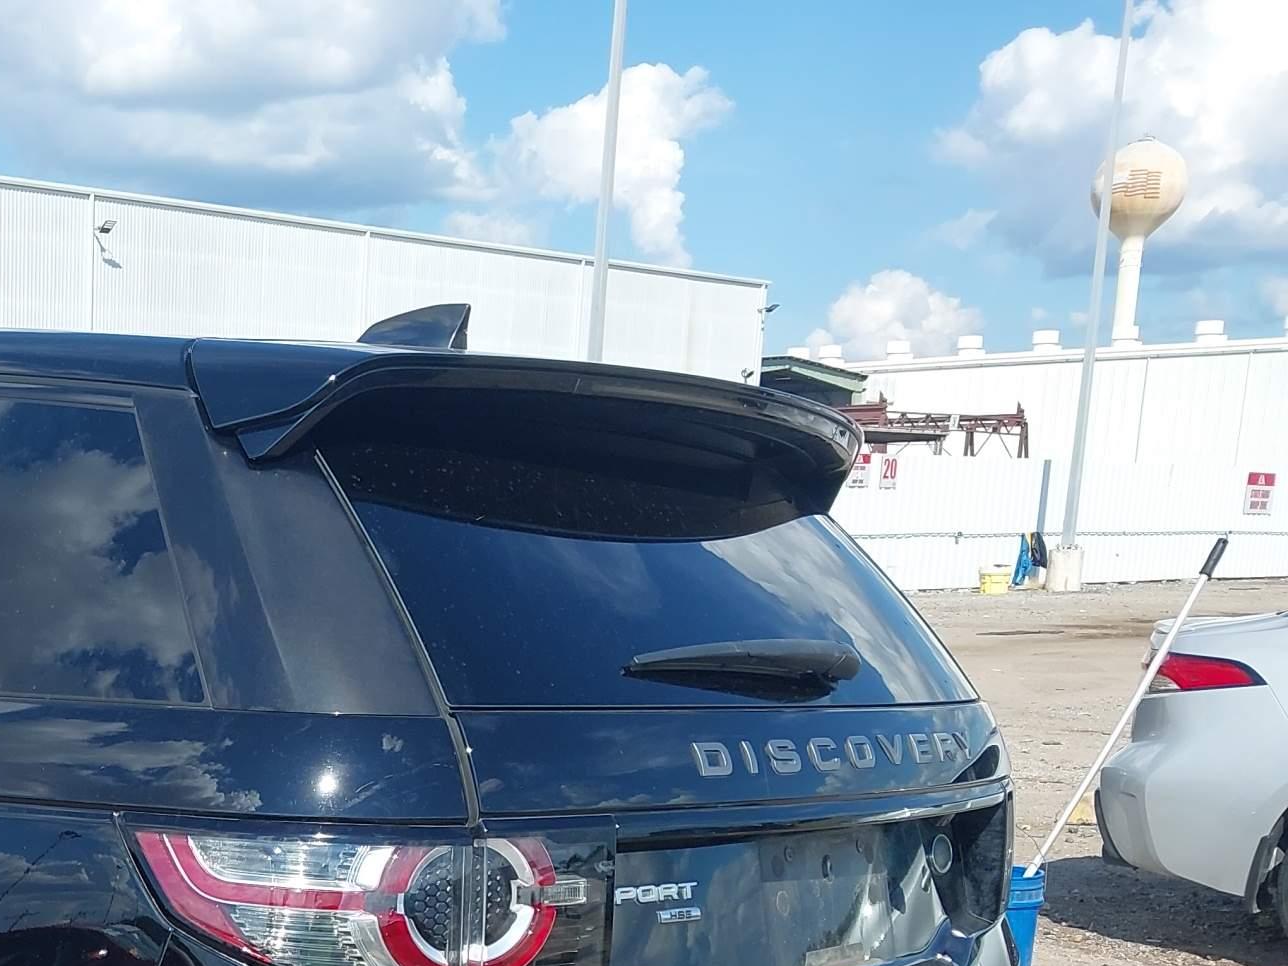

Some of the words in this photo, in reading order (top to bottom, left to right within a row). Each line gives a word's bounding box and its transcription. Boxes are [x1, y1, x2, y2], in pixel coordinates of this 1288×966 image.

[882, 458, 898, 479] 20
[690, 731, 973, 777] DISCOVERY
[614, 881, 698, 905] PORT
[670, 910, 692, 919] HSE
